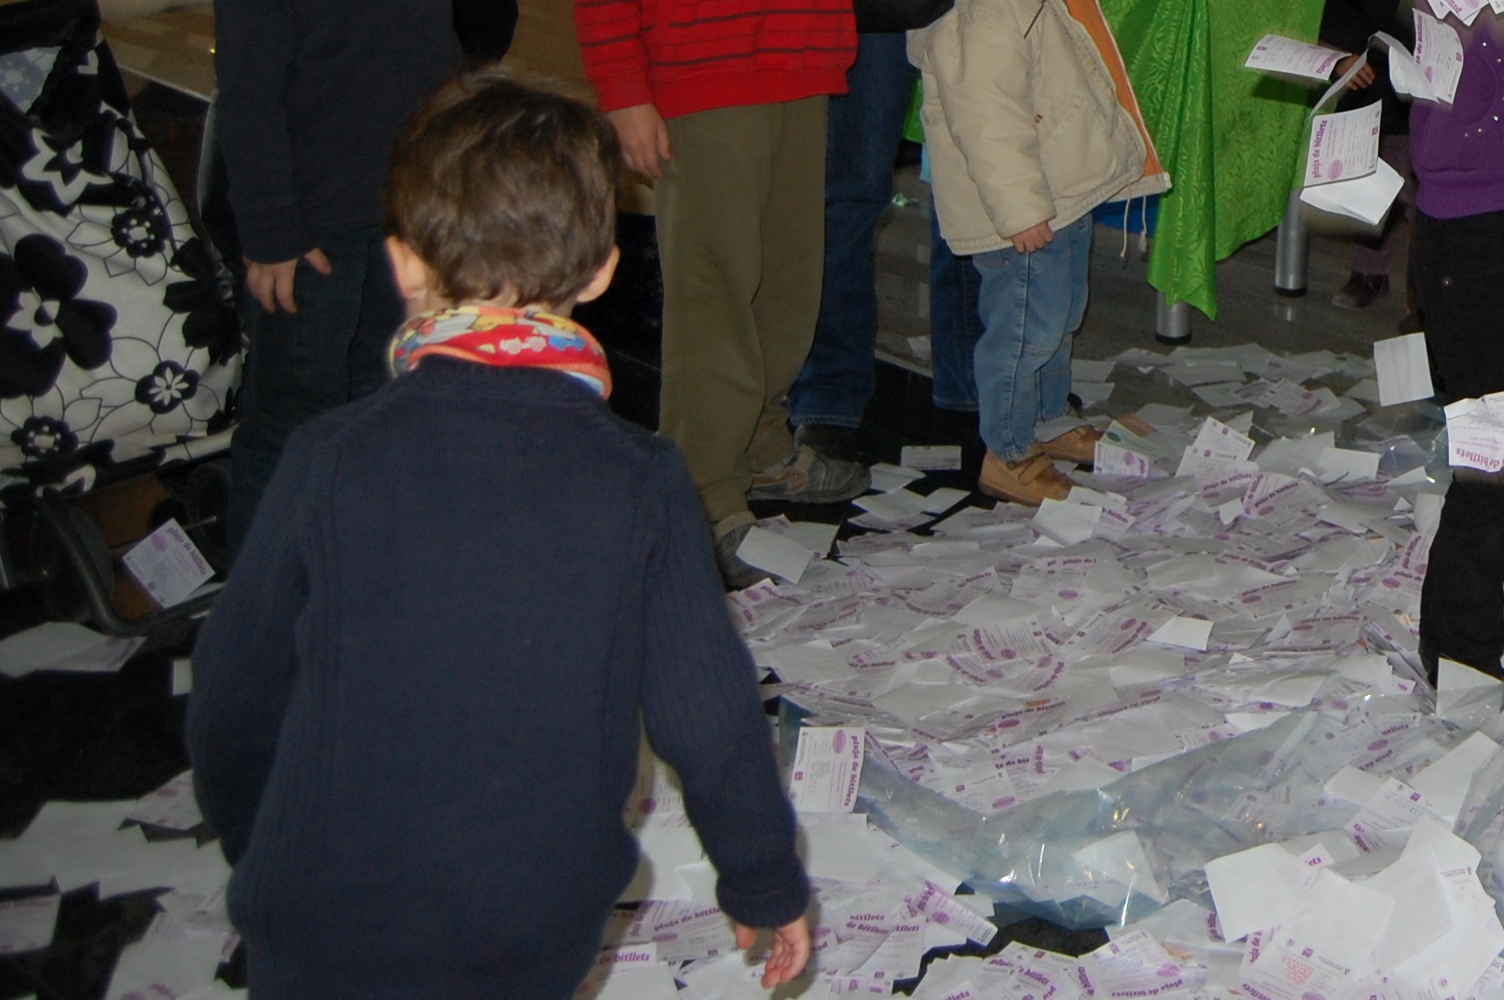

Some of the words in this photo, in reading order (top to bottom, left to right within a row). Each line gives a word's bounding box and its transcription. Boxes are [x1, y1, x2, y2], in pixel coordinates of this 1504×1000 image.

[1456, 447, 1489, 468] bitllets
[851, 734, 862, 760] pluja
[852, 760, 861, 772] de
[844, 772, 860, 808] bitllets
[654, 919, 680, 932] pluja
[694, 906, 722, 918] bitlle
[857, 923, 890, 936] bitllets
[613, 951, 651, 963] bitllets
